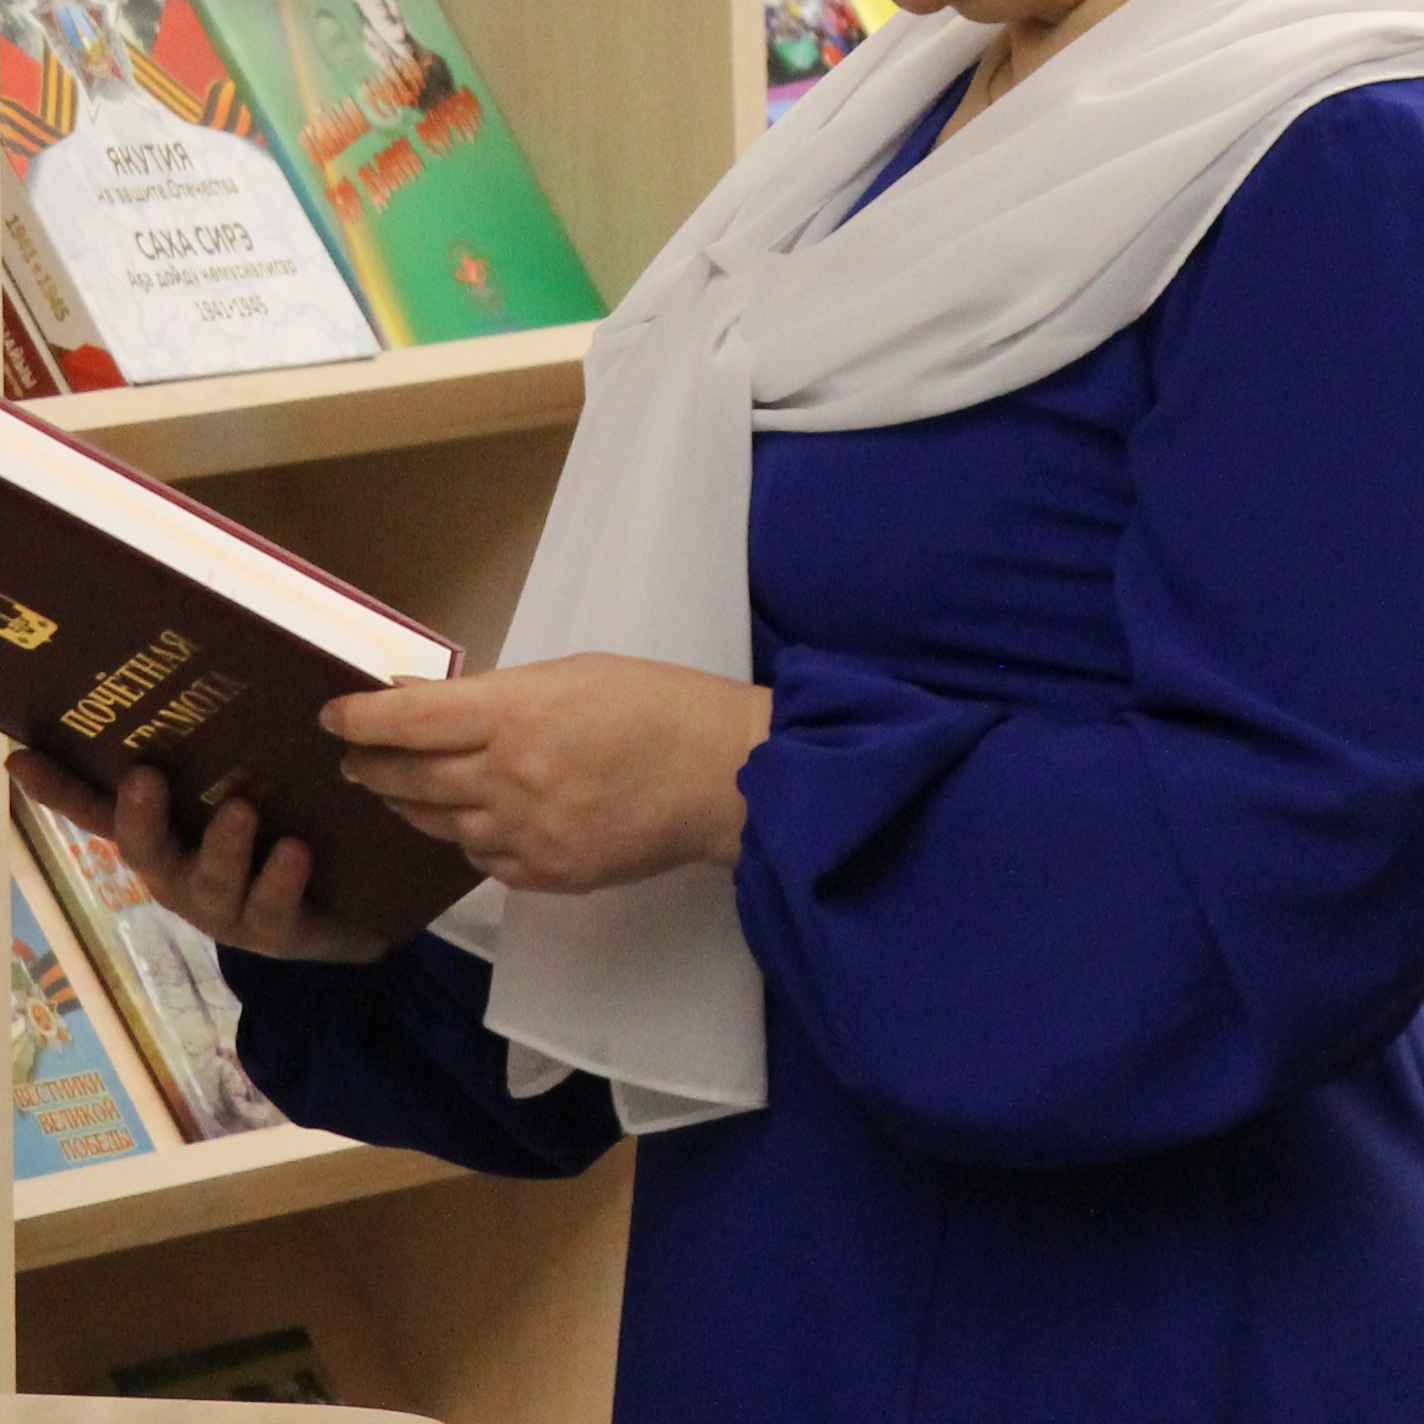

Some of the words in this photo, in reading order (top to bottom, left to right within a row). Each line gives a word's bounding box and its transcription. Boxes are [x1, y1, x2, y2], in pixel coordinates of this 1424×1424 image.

[106, 142, 196, 176] ЯКУТИЯ
[134, 226, 198, 261] САХА
[194, 222, 255, 257] СИРЭ
[60, 629, 200, 738] ПОЧЁТНАЯ
[13, 1071, 106, 1109] ВЕСТНИКИ
[37, 1097, 122, 1137] ВЕЛИКОЙ
[59, 1128, 137, 1164] ПОБЕДЫ
